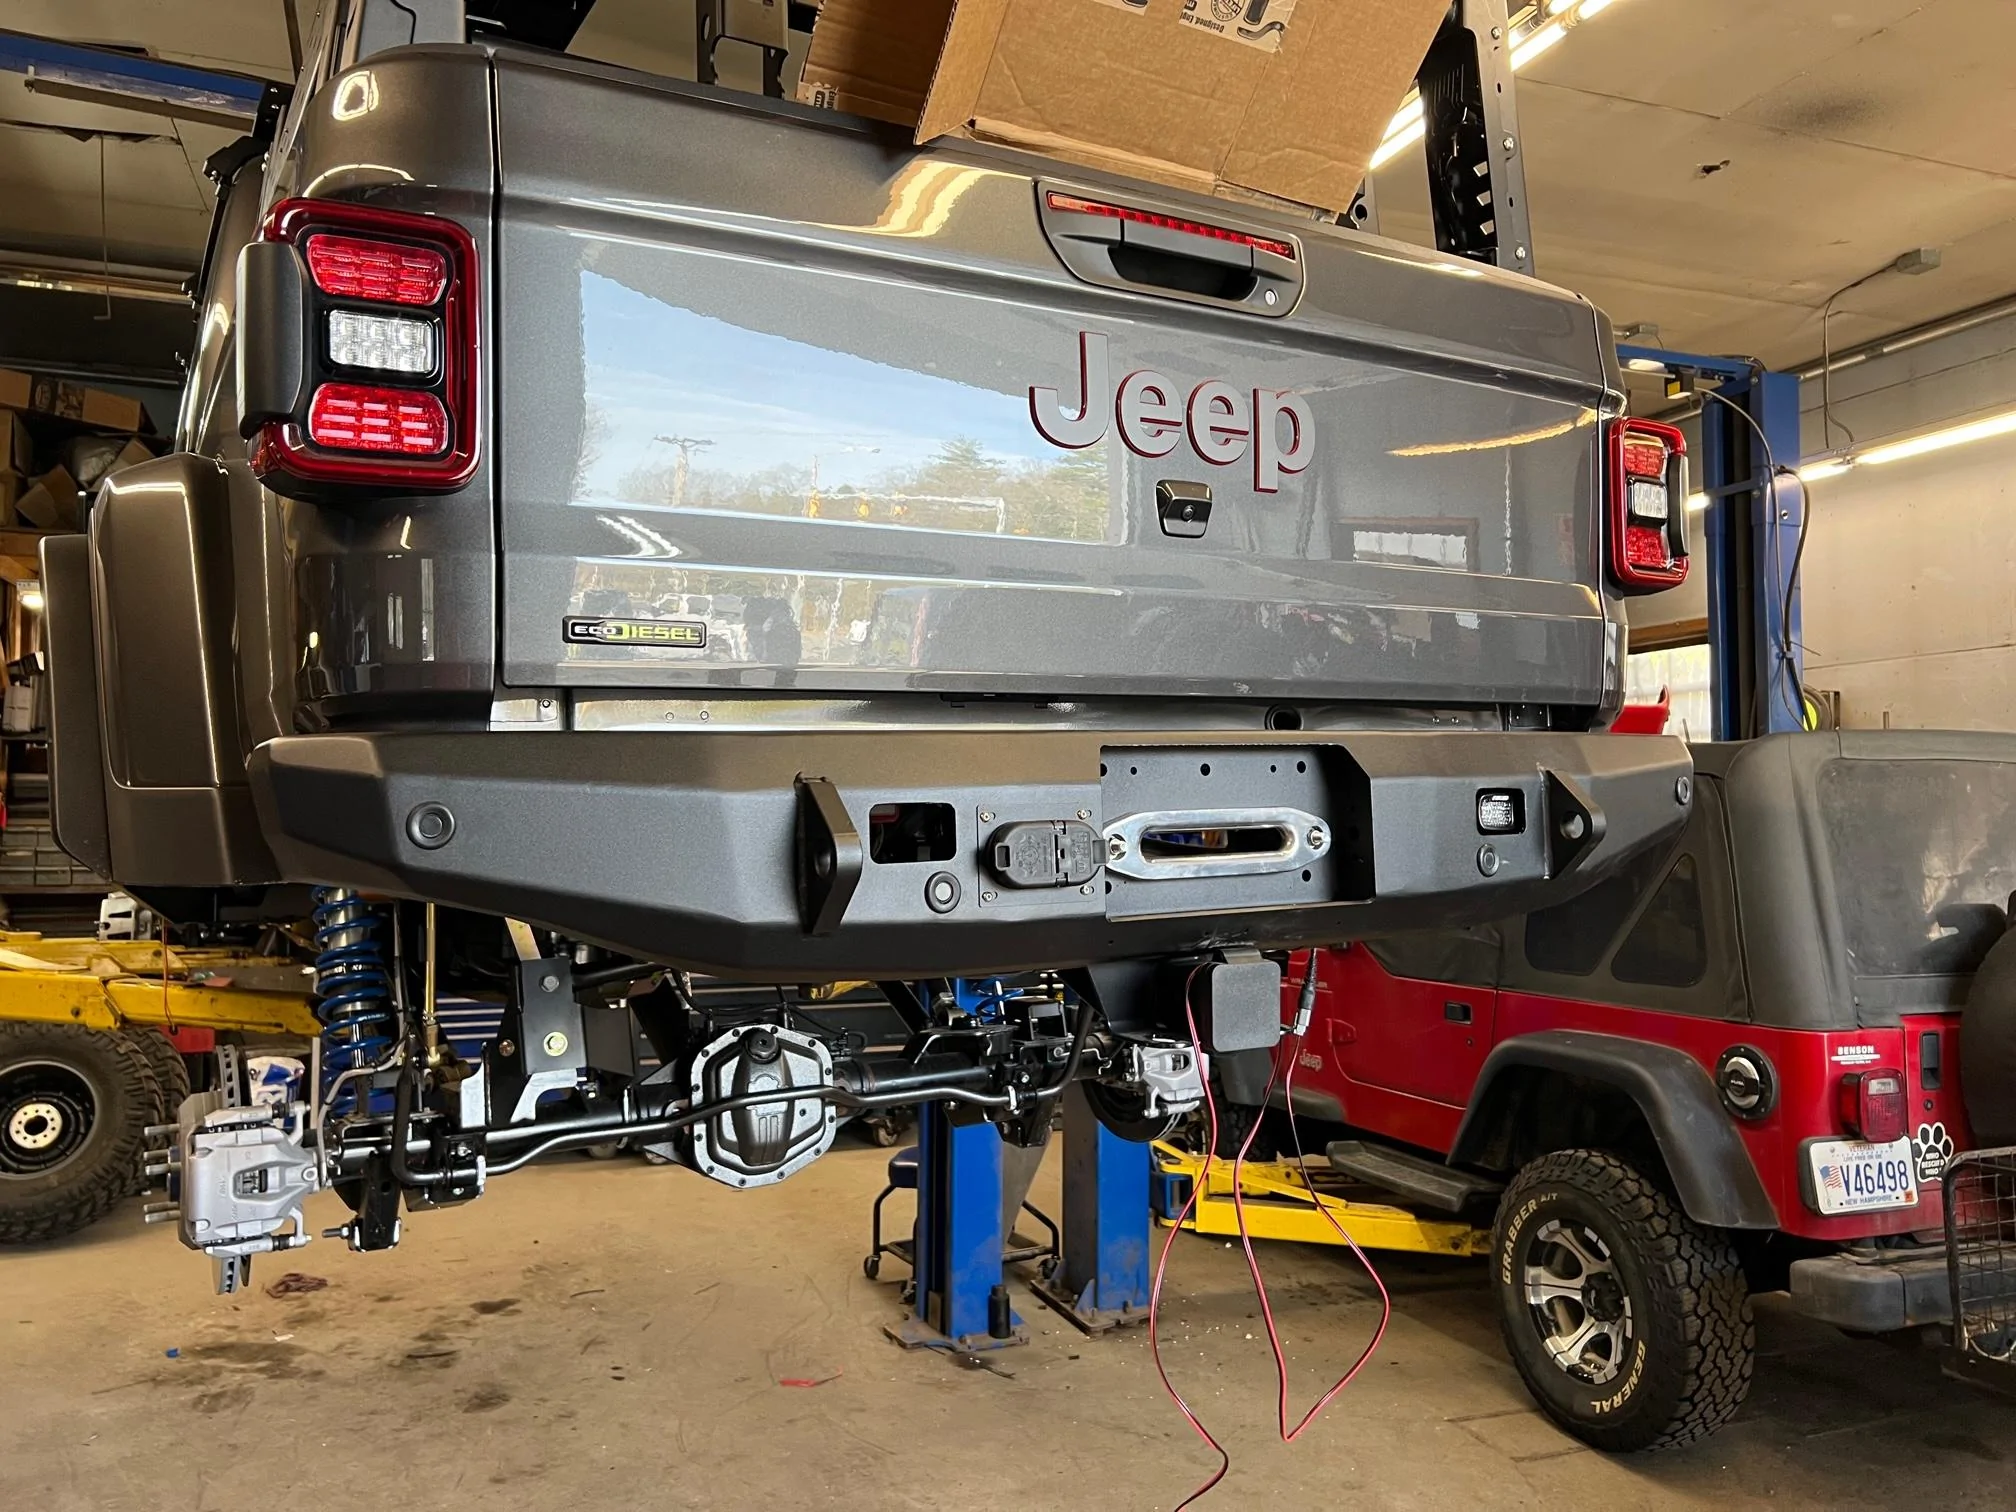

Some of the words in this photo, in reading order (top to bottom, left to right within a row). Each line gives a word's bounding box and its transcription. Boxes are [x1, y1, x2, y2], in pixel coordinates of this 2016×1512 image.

[1029, 331, 1315, 493] Jeep
[1299, 1048, 1323, 1073] Jeep
[1837, 1045, 1874, 1056] BENSON
[1839, 1160, 1909, 1196] V46498
[1845, 1197, 1858, 1205] NEW
[1860, 1194, 1893, 1203] HAMPSHIRE
[1502, 1199, 1538, 1285] GRABBER
[1590, 1340, 1646, 1413] GENERAL
